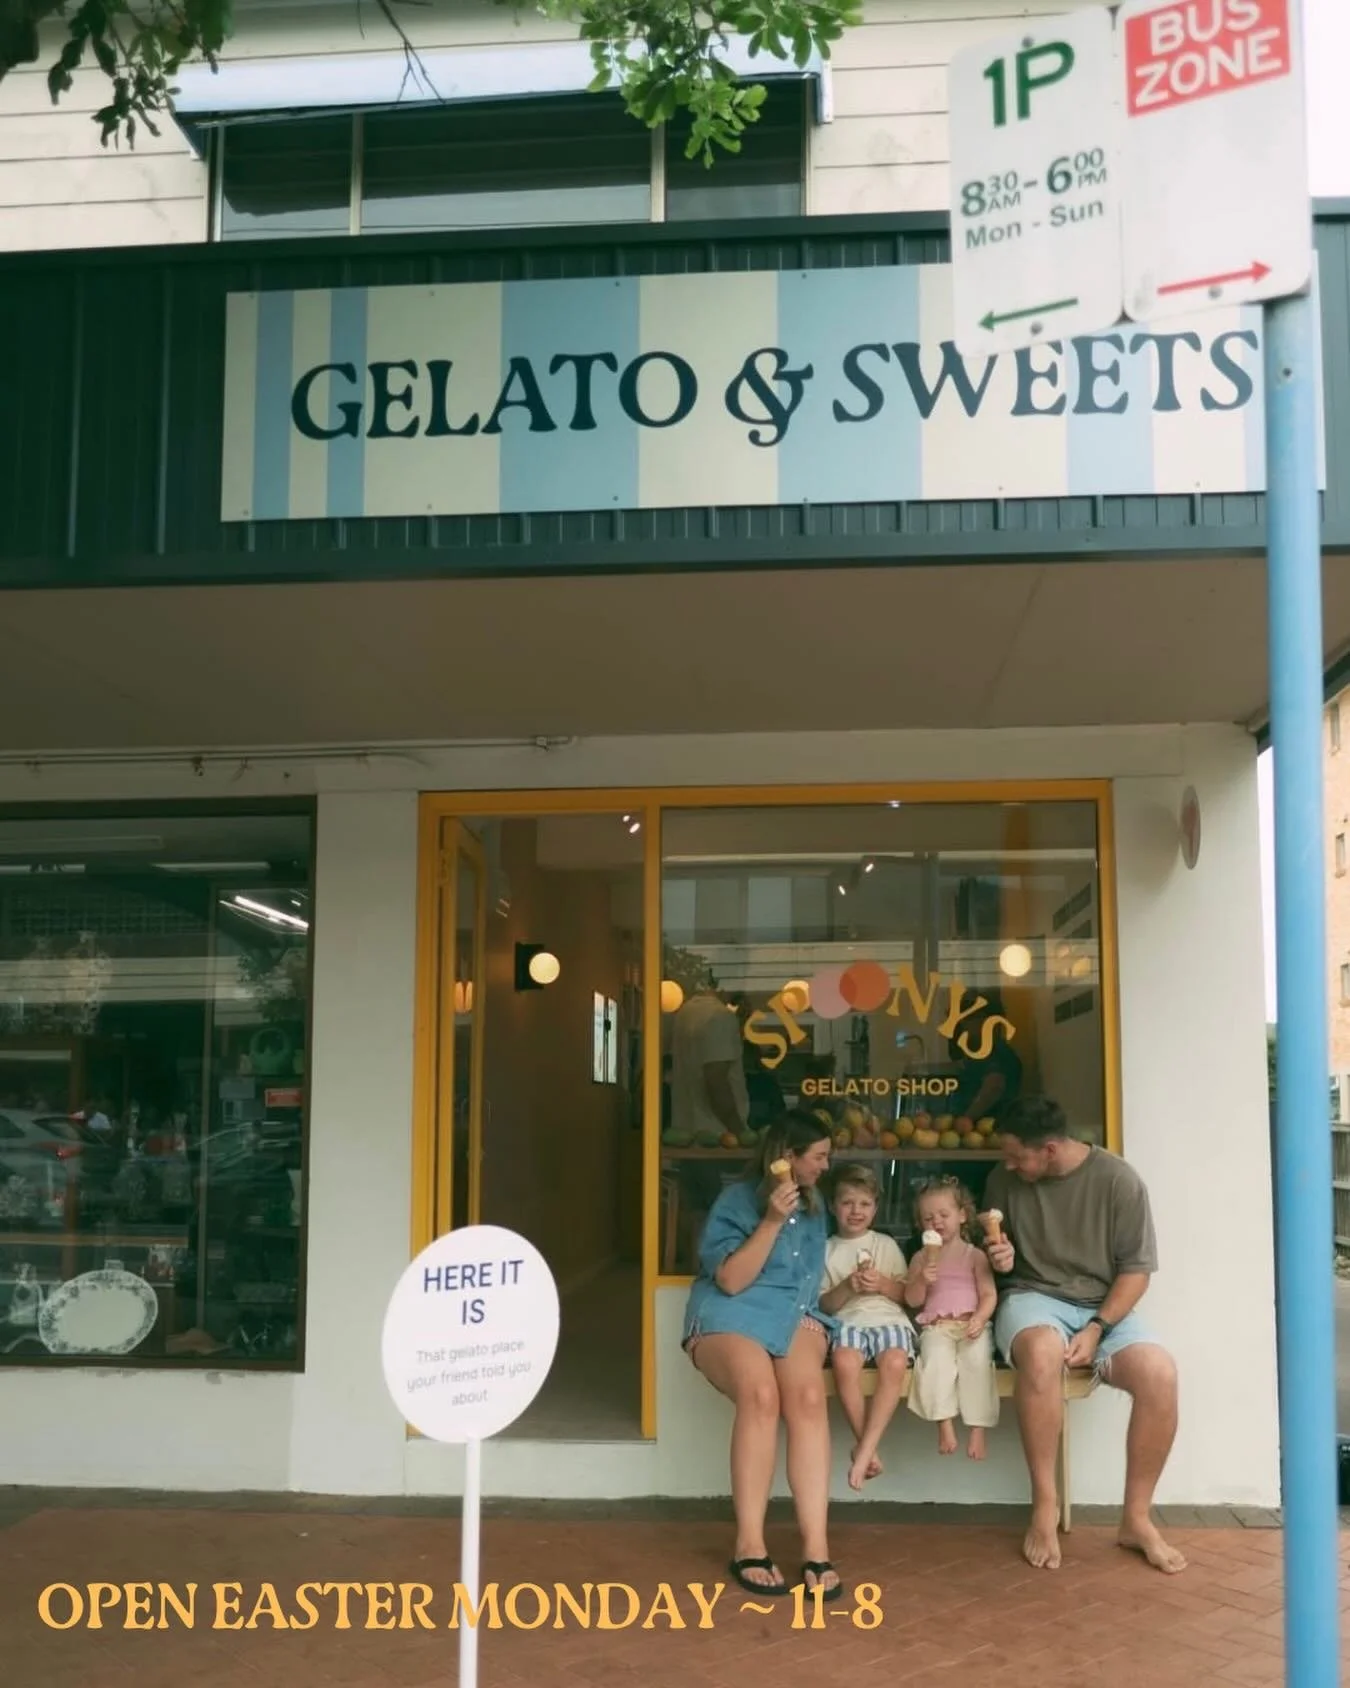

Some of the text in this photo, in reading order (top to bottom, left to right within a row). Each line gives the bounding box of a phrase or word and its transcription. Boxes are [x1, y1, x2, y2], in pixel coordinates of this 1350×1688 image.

[1151, 0, 1260, 56] BUS
[984, 41, 1075, 127] 1P
[1135, 27, 1282, 108] ZONE
[987, 191, 1022, 213] AM
[1077, 168, 1108, 188] PM
[965, 223, 1022, 249] Mon
[1049, 199, 1104, 228] Sun
[291, 330, 1258, 447] GELATO & SWEETS
[801, 1077, 959, 1096] GELATO SHOP
[423, 1259, 524, 1293] HERE IT
[461, 1298, 486, 1325] IS
[416, 1338, 525, 1363] That gelato place
[407, 1360, 532, 1393] your friend told you
[451, 1389, 488, 1406] about
